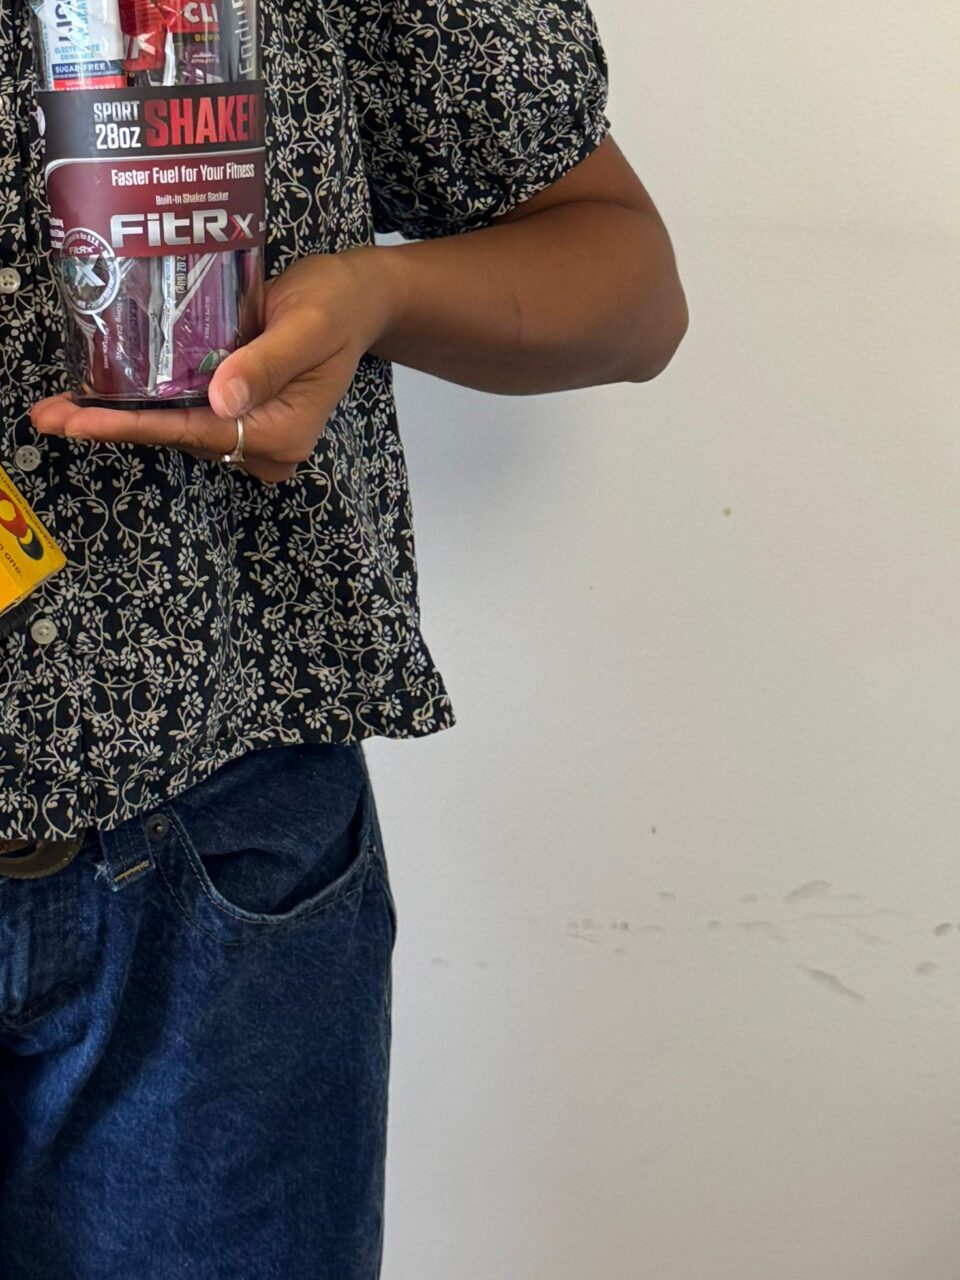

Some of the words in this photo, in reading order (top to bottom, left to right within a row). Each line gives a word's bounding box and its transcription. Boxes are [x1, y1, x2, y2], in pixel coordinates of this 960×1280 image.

[182, 2, 219, 24] CLI
[93, 100, 140, 122] SPORT
[111, 169, 150, 187] Faster
[152, 167, 178, 185] Fuel
[181, 165, 197, 182] for
[200, 164, 224, 181] Your
[226, 162, 255, 179] Fitness
[183, 193, 207, 204] Shaker
